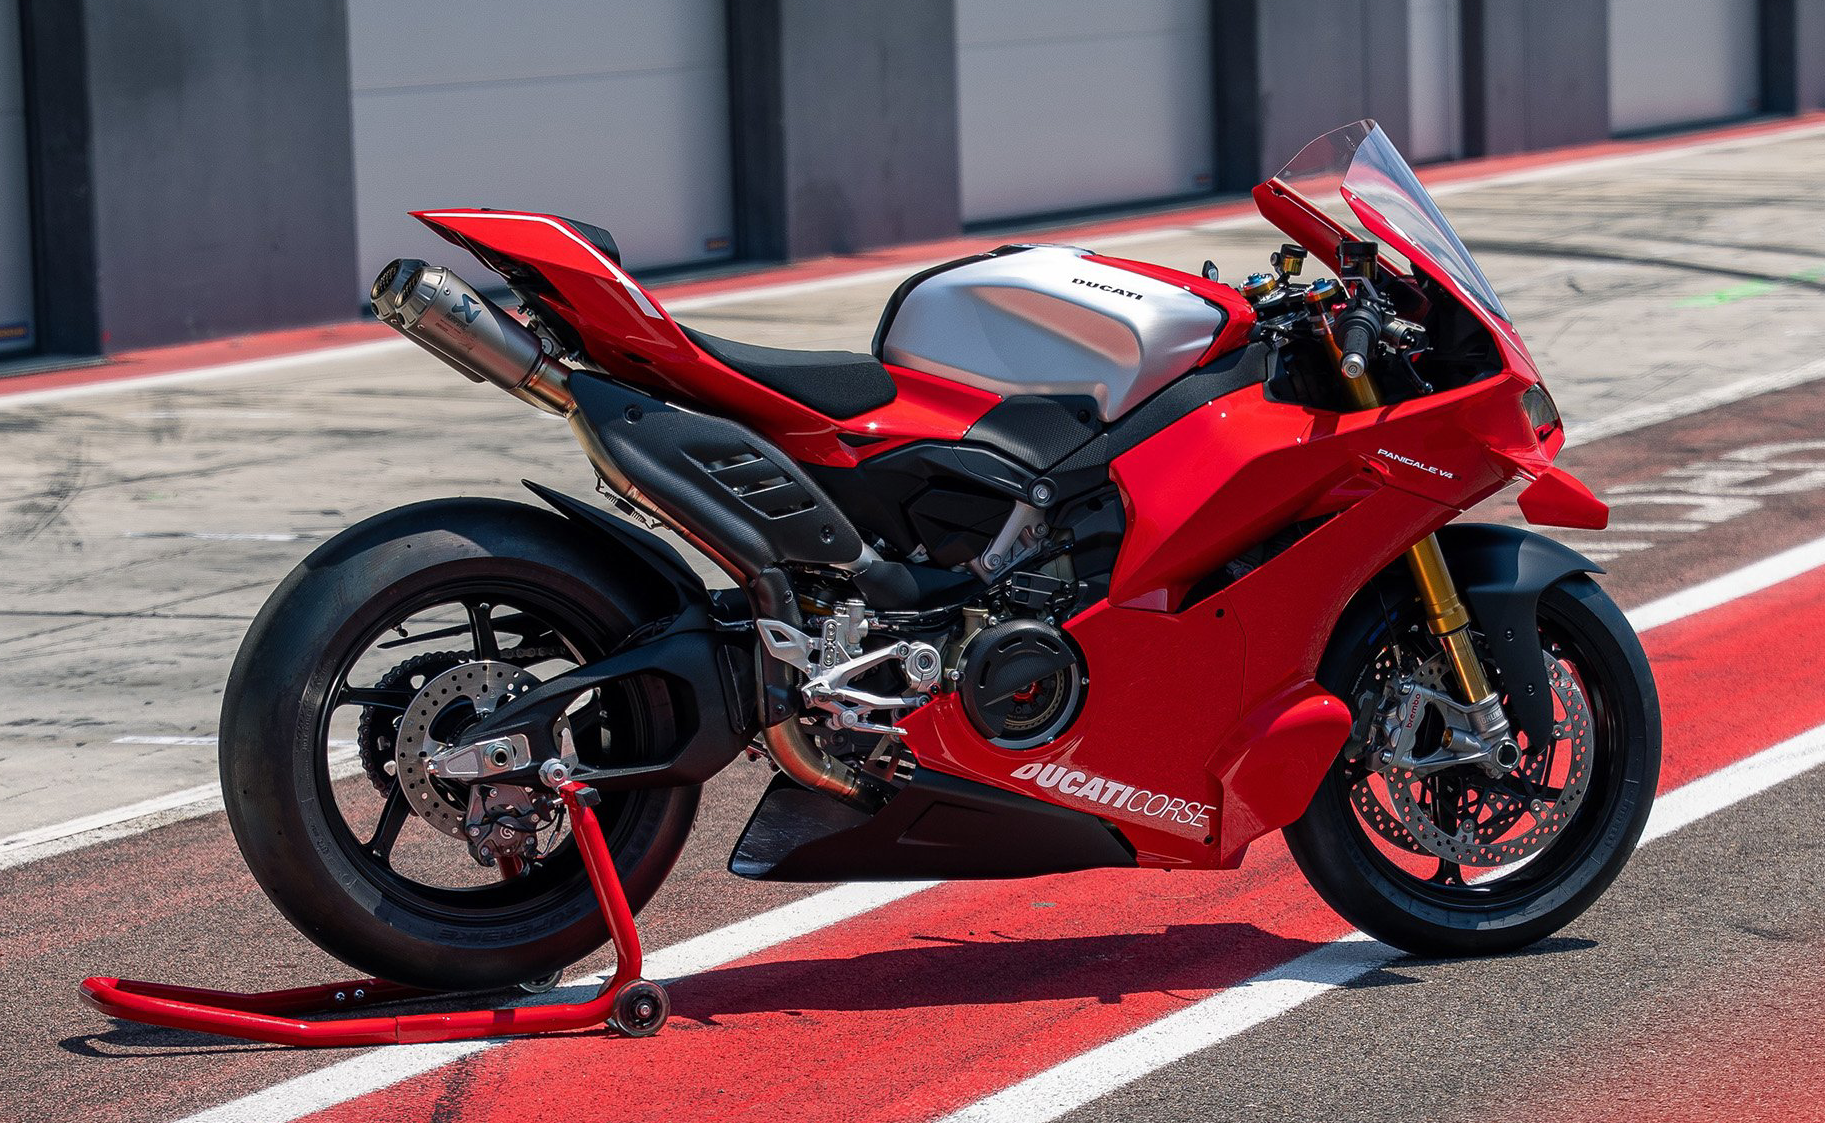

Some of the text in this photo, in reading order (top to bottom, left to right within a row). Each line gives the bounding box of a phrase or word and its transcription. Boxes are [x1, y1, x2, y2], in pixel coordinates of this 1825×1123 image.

[1072, 278, 1143, 300] DUCATI
[1377, 448, 1438, 474] PANIGALE
[1405, 693, 1421, 728] brembo
